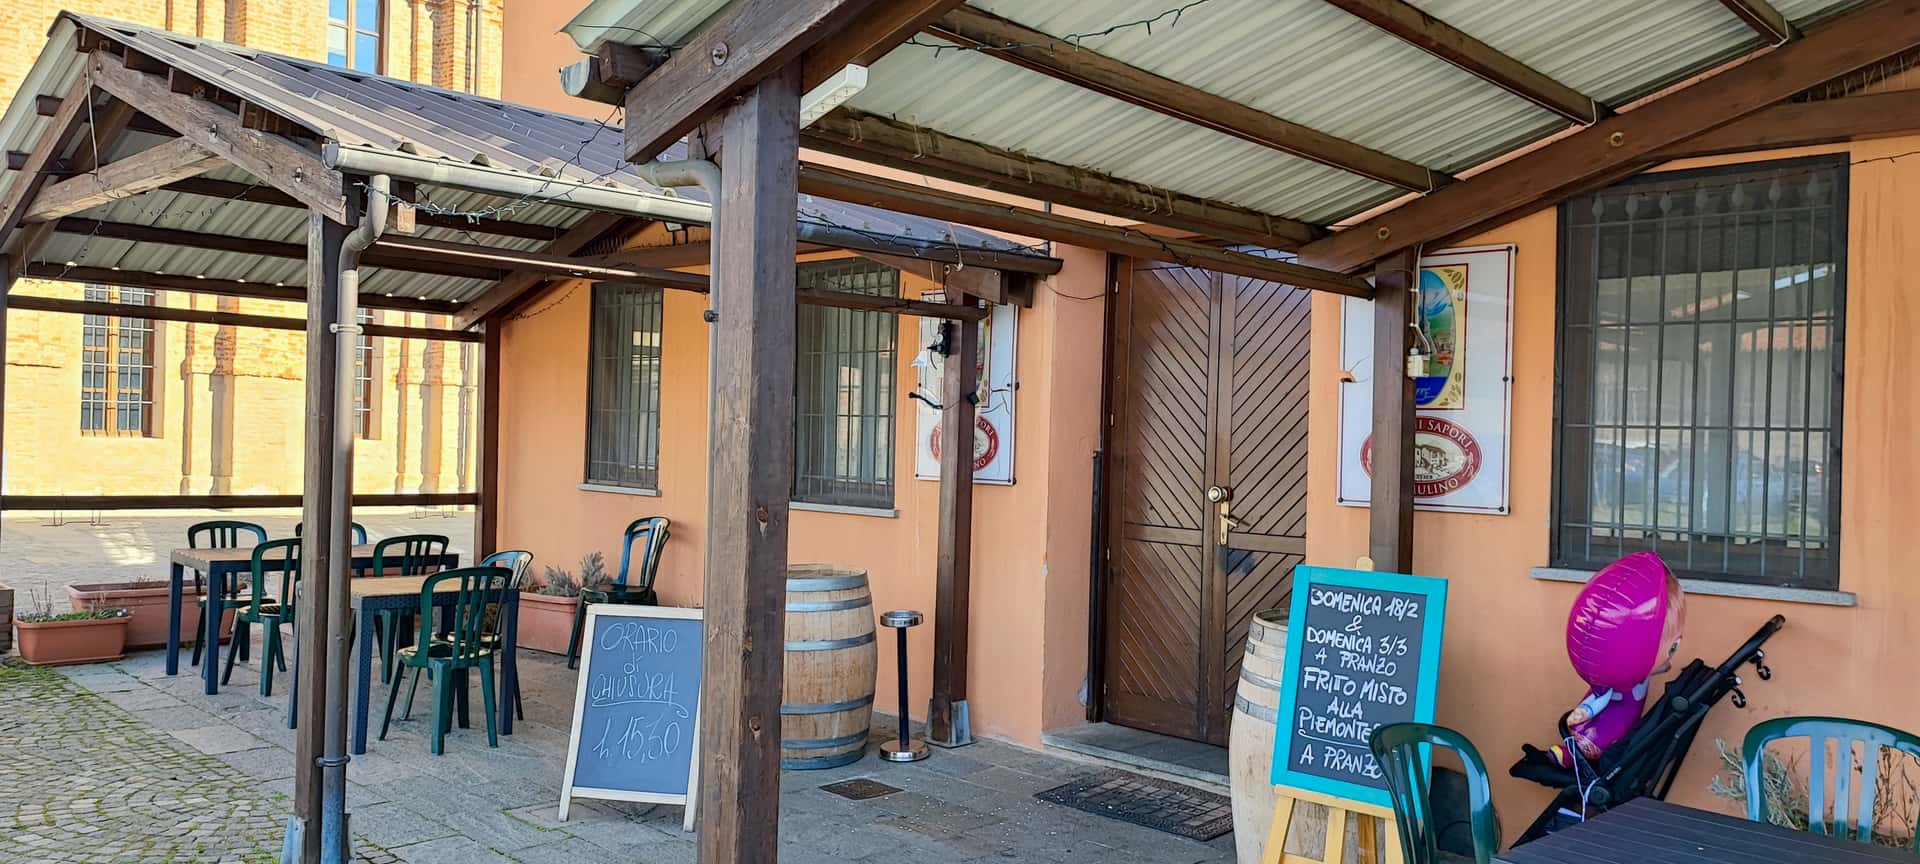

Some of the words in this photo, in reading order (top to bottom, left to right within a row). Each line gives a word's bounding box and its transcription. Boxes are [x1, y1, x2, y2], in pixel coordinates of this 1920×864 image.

[1427, 419, 1473, 453] SAPORI
[1415, 478, 1458, 495] ULINO
[1310, 588, 1382, 616] DOMENICA
[1384, 597, 1419, 622] 18/2
[1345, 614, 1363, 632] &
[600, 622, 678, 654] ORARIO
[1306, 626, 1372, 654] DOMENICA
[1379, 635, 1408, 656] 3/3
[1315, 647, 1327, 665] A
[1339, 650, 1397, 676] PRANZO
[1359, 678, 1408, 706] MISTO
[1326, 695, 1363, 720] ALLA
[1299, 706, 1381, 743] PIEMONTE
[1300, 743, 1315, 765] A
